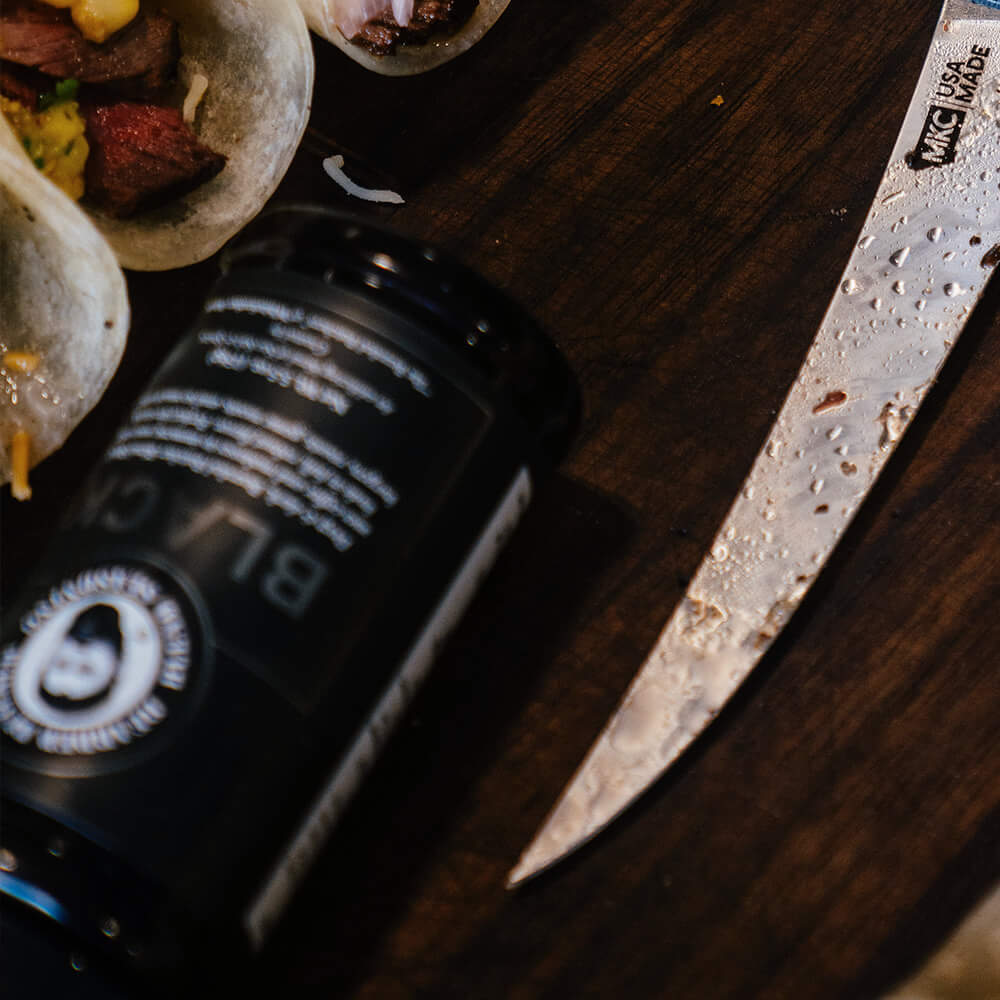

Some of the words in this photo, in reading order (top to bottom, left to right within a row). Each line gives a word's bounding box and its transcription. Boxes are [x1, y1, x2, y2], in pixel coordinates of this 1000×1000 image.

[936, 59, 966, 99] USA
[955, 43, 991, 104] MADE
[919, 106, 962, 166] MKC
